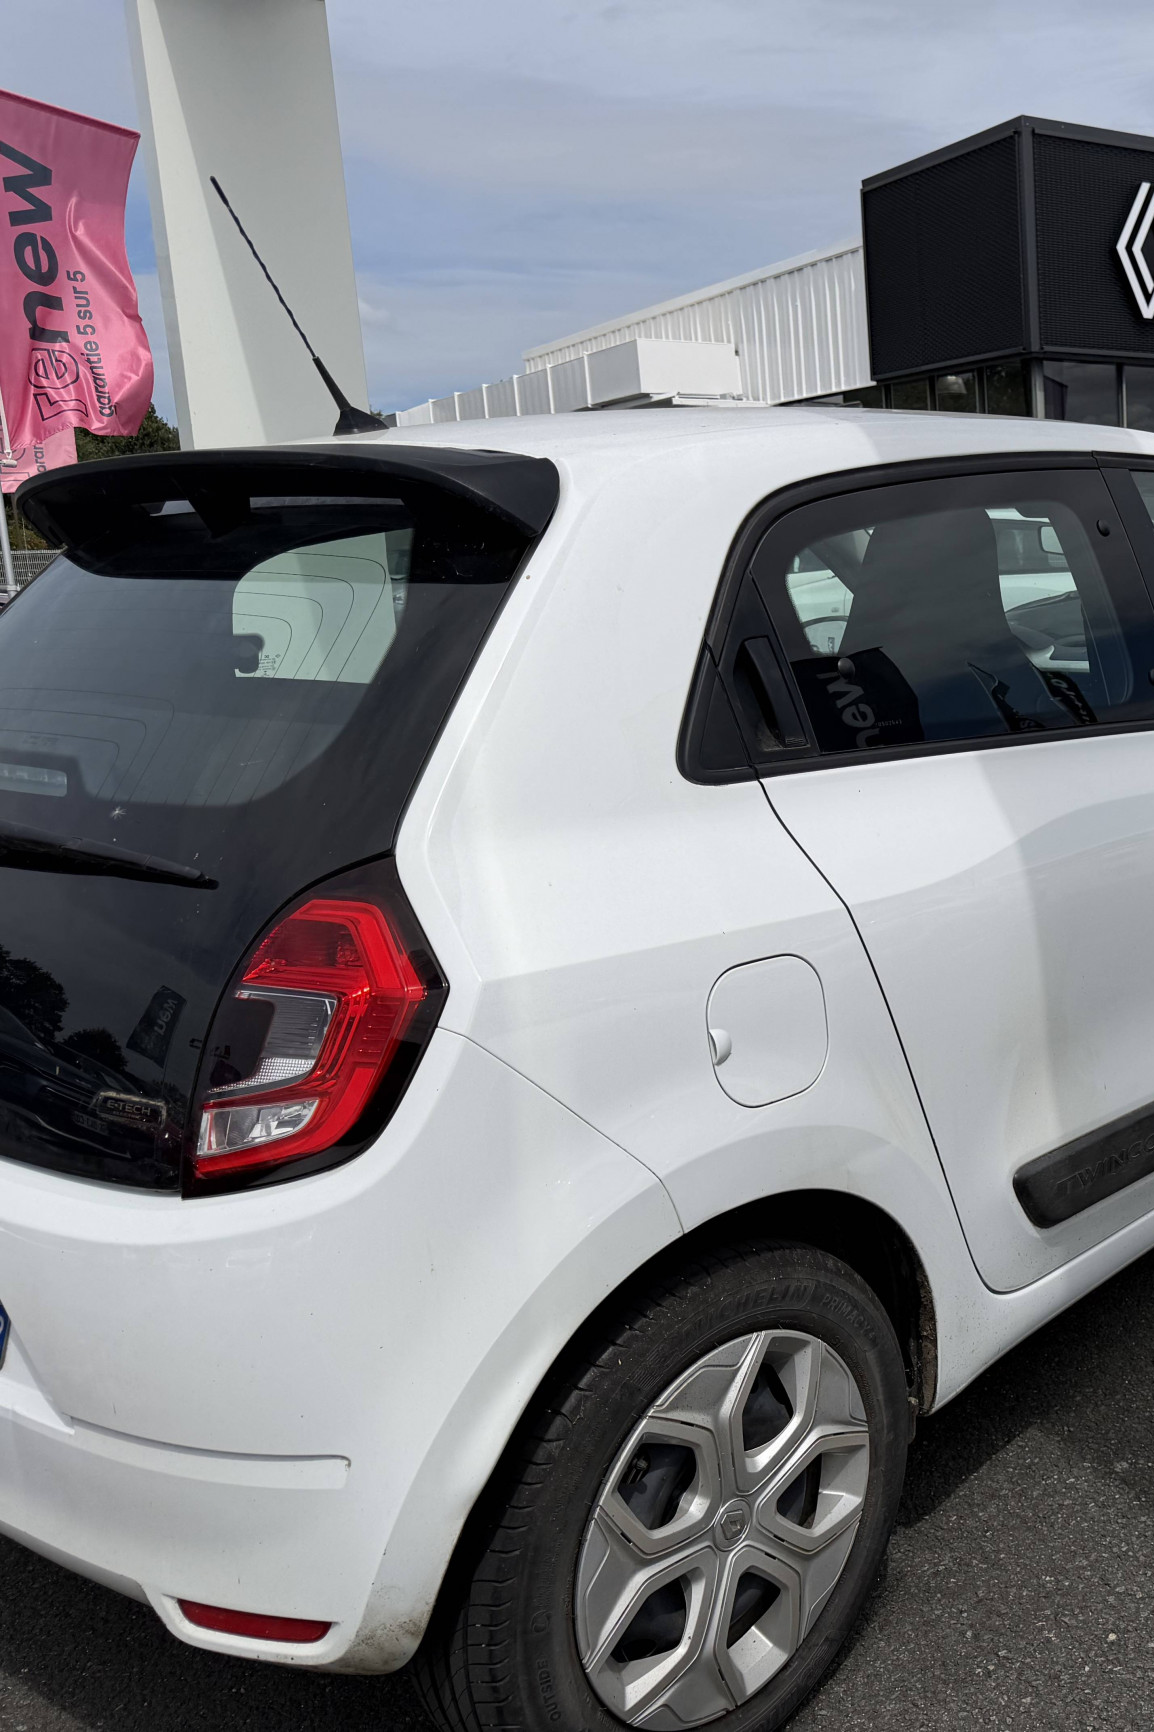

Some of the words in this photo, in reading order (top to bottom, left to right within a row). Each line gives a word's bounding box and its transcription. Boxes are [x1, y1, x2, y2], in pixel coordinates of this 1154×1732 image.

[66, 269, 86, 283] 5
[73, 286, 94, 320] sur
[76, 324, 96, 337] 5
[79, 341, 116, 419] garantie
[106, 1099, 151, 1117] E-TECH
[820, 1293, 871, 1334] PRIMACY
[536, 1658, 561, 1723] OUTSIDE
